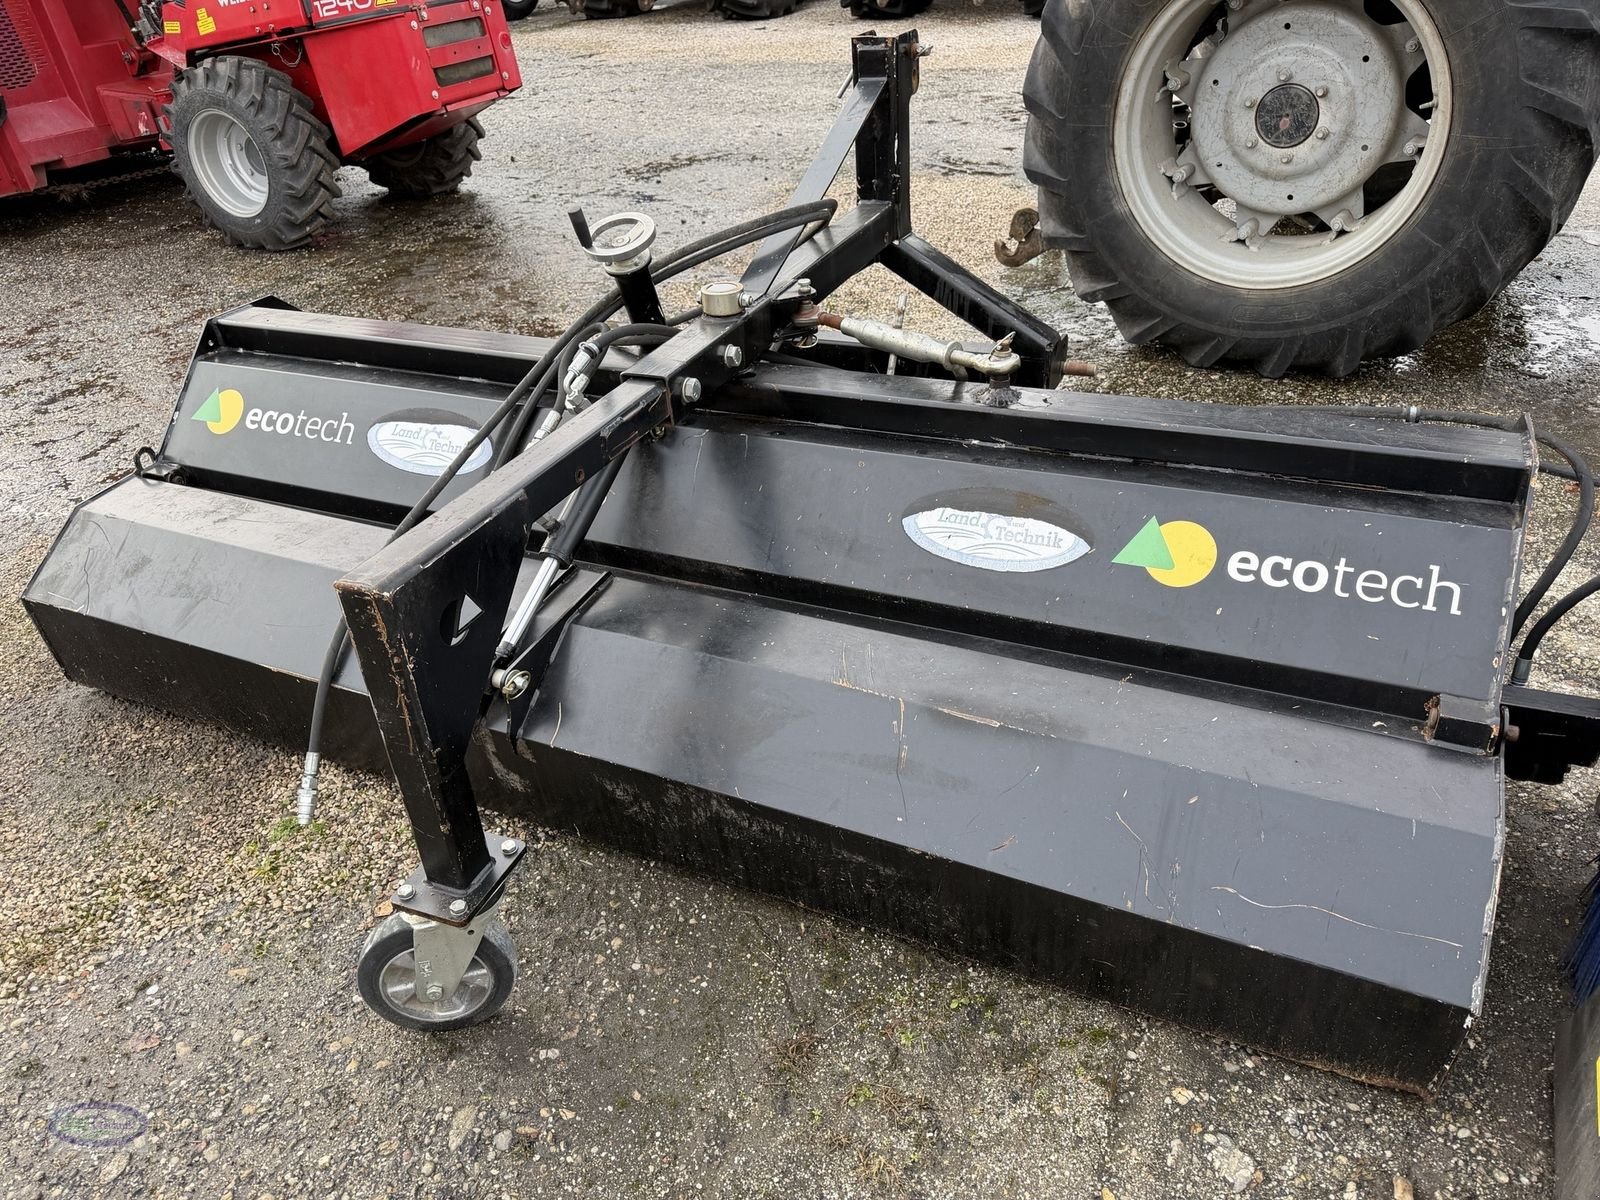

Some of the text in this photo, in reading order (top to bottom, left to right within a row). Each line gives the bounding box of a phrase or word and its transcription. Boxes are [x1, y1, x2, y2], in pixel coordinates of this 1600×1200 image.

[245, 408, 355, 445] ecotech
[391, 424, 422, 440] Land
[428, 438, 463, 455] Techn
[937, 508, 982, 528] Land
[995, 526, 1063, 549] Technik
[1227, 550, 1462, 616] ecotech
